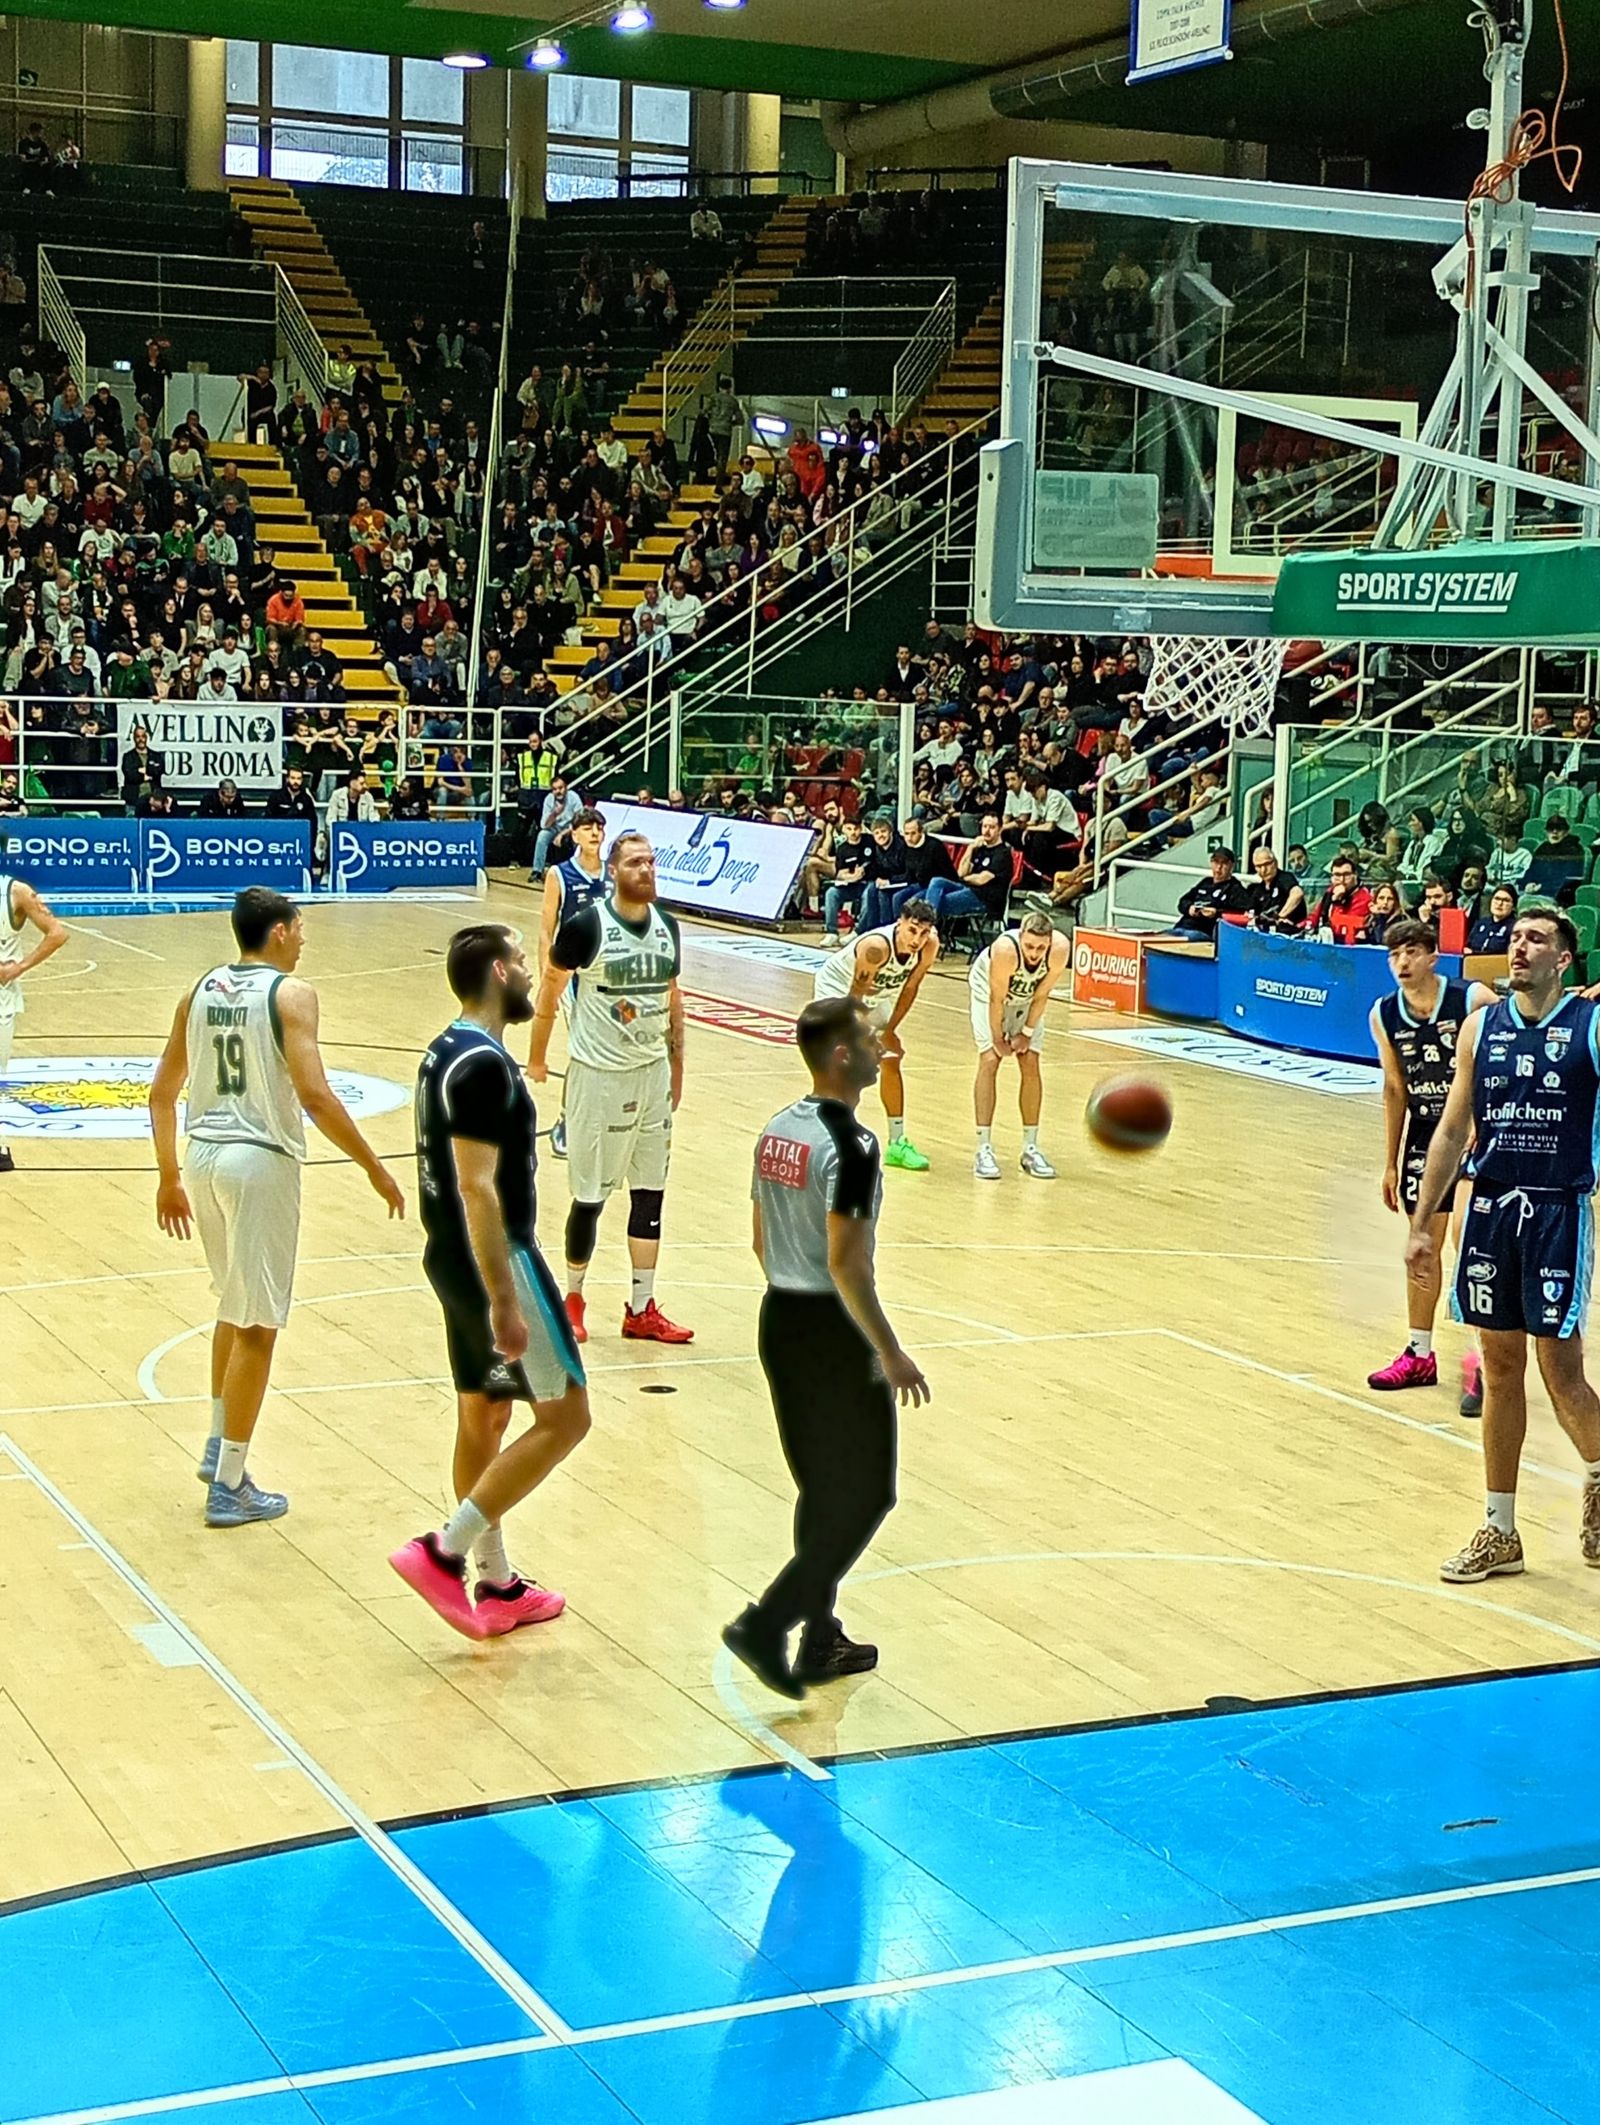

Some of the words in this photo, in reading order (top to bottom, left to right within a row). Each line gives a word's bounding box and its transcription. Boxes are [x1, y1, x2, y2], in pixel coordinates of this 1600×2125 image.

[202, 751, 275, 777] ROMA
[7, 838, 89, 854] BONO
[186, 838, 264, 855] BONO
[373, 840, 443, 856] BONO
[6, 858, 131, 866] INGEGNERIA
[186, 858, 303, 867] INGEGNERIA
[373, 859, 478, 868] INGEGNERIA
[1091, 951, 1137, 977] DURING
[1422, 1044, 1440, 1062] 26
[212, 1033, 247, 1097] 19
[1515, 1054, 1535, 1077] 16
[1407, 1080, 1451, 1095] Liofilch
[1482, 1102, 1562, 1121] iofilchem
[763, 1138, 802, 1166] ATTAL
[1406, 1176, 1422, 1201] 2
[1467, 1280, 1493, 1315] 16
